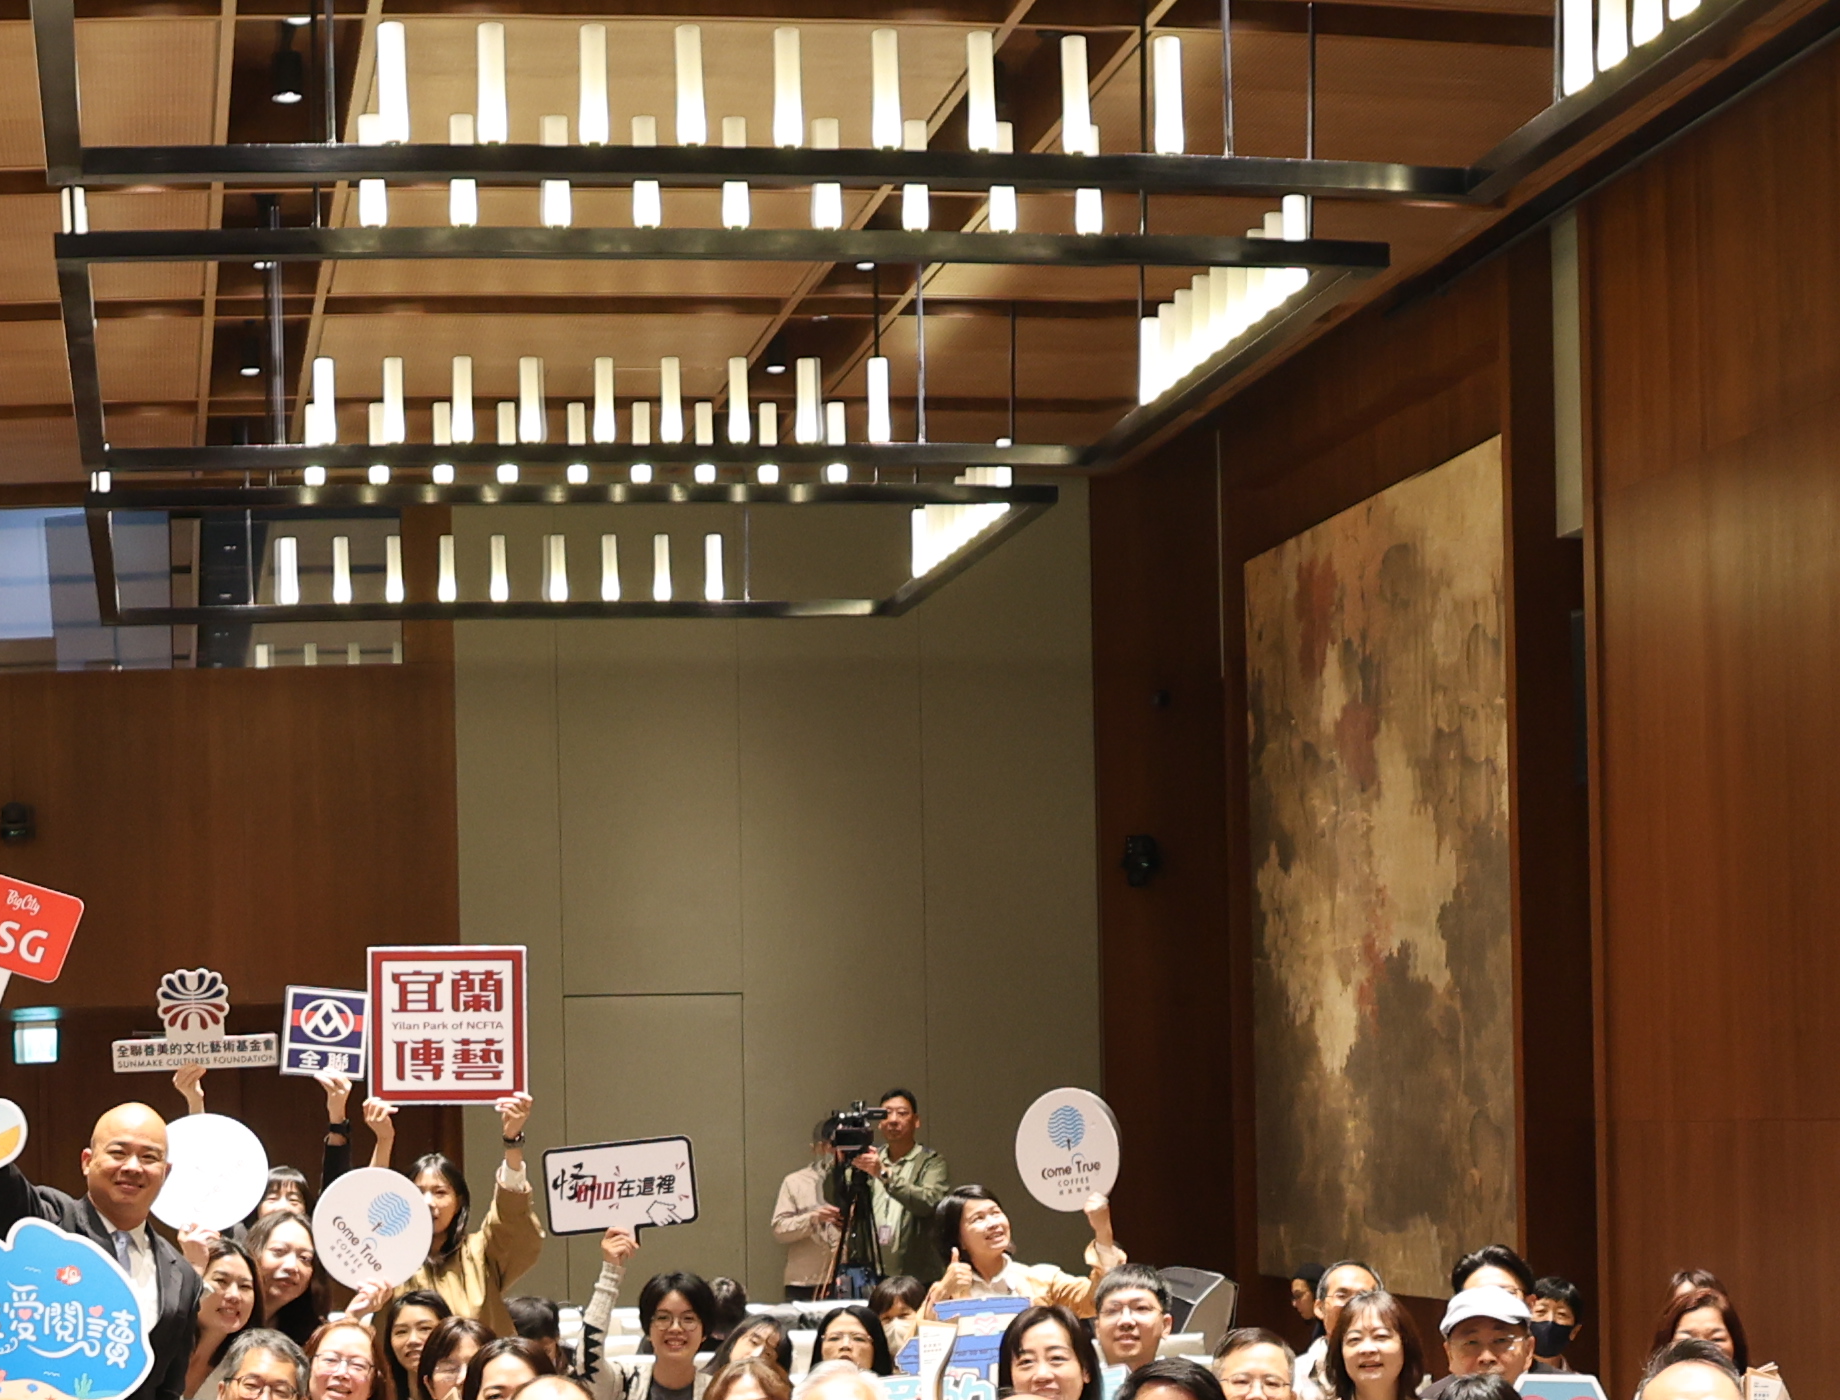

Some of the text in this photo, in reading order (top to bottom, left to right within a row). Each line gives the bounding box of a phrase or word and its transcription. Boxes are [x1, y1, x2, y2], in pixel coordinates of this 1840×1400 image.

[391, 970, 504, 1012] 宜蘭
[392, 1021, 504, 1031] Yilan Park of NCFTA
[117, 1059, 163, 1068] SUNMAKE
[214, 1054, 276, 1064] FOUNDATION
[299, 1050, 349, 1072] 全聯
[392, 1038, 504, 1081] 傳藝
[552, 1162, 676, 1210] 怪咖在這裡
[1041, 1161, 1101, 1180] Come True
[332, 1215, 382, 1272] Come True
